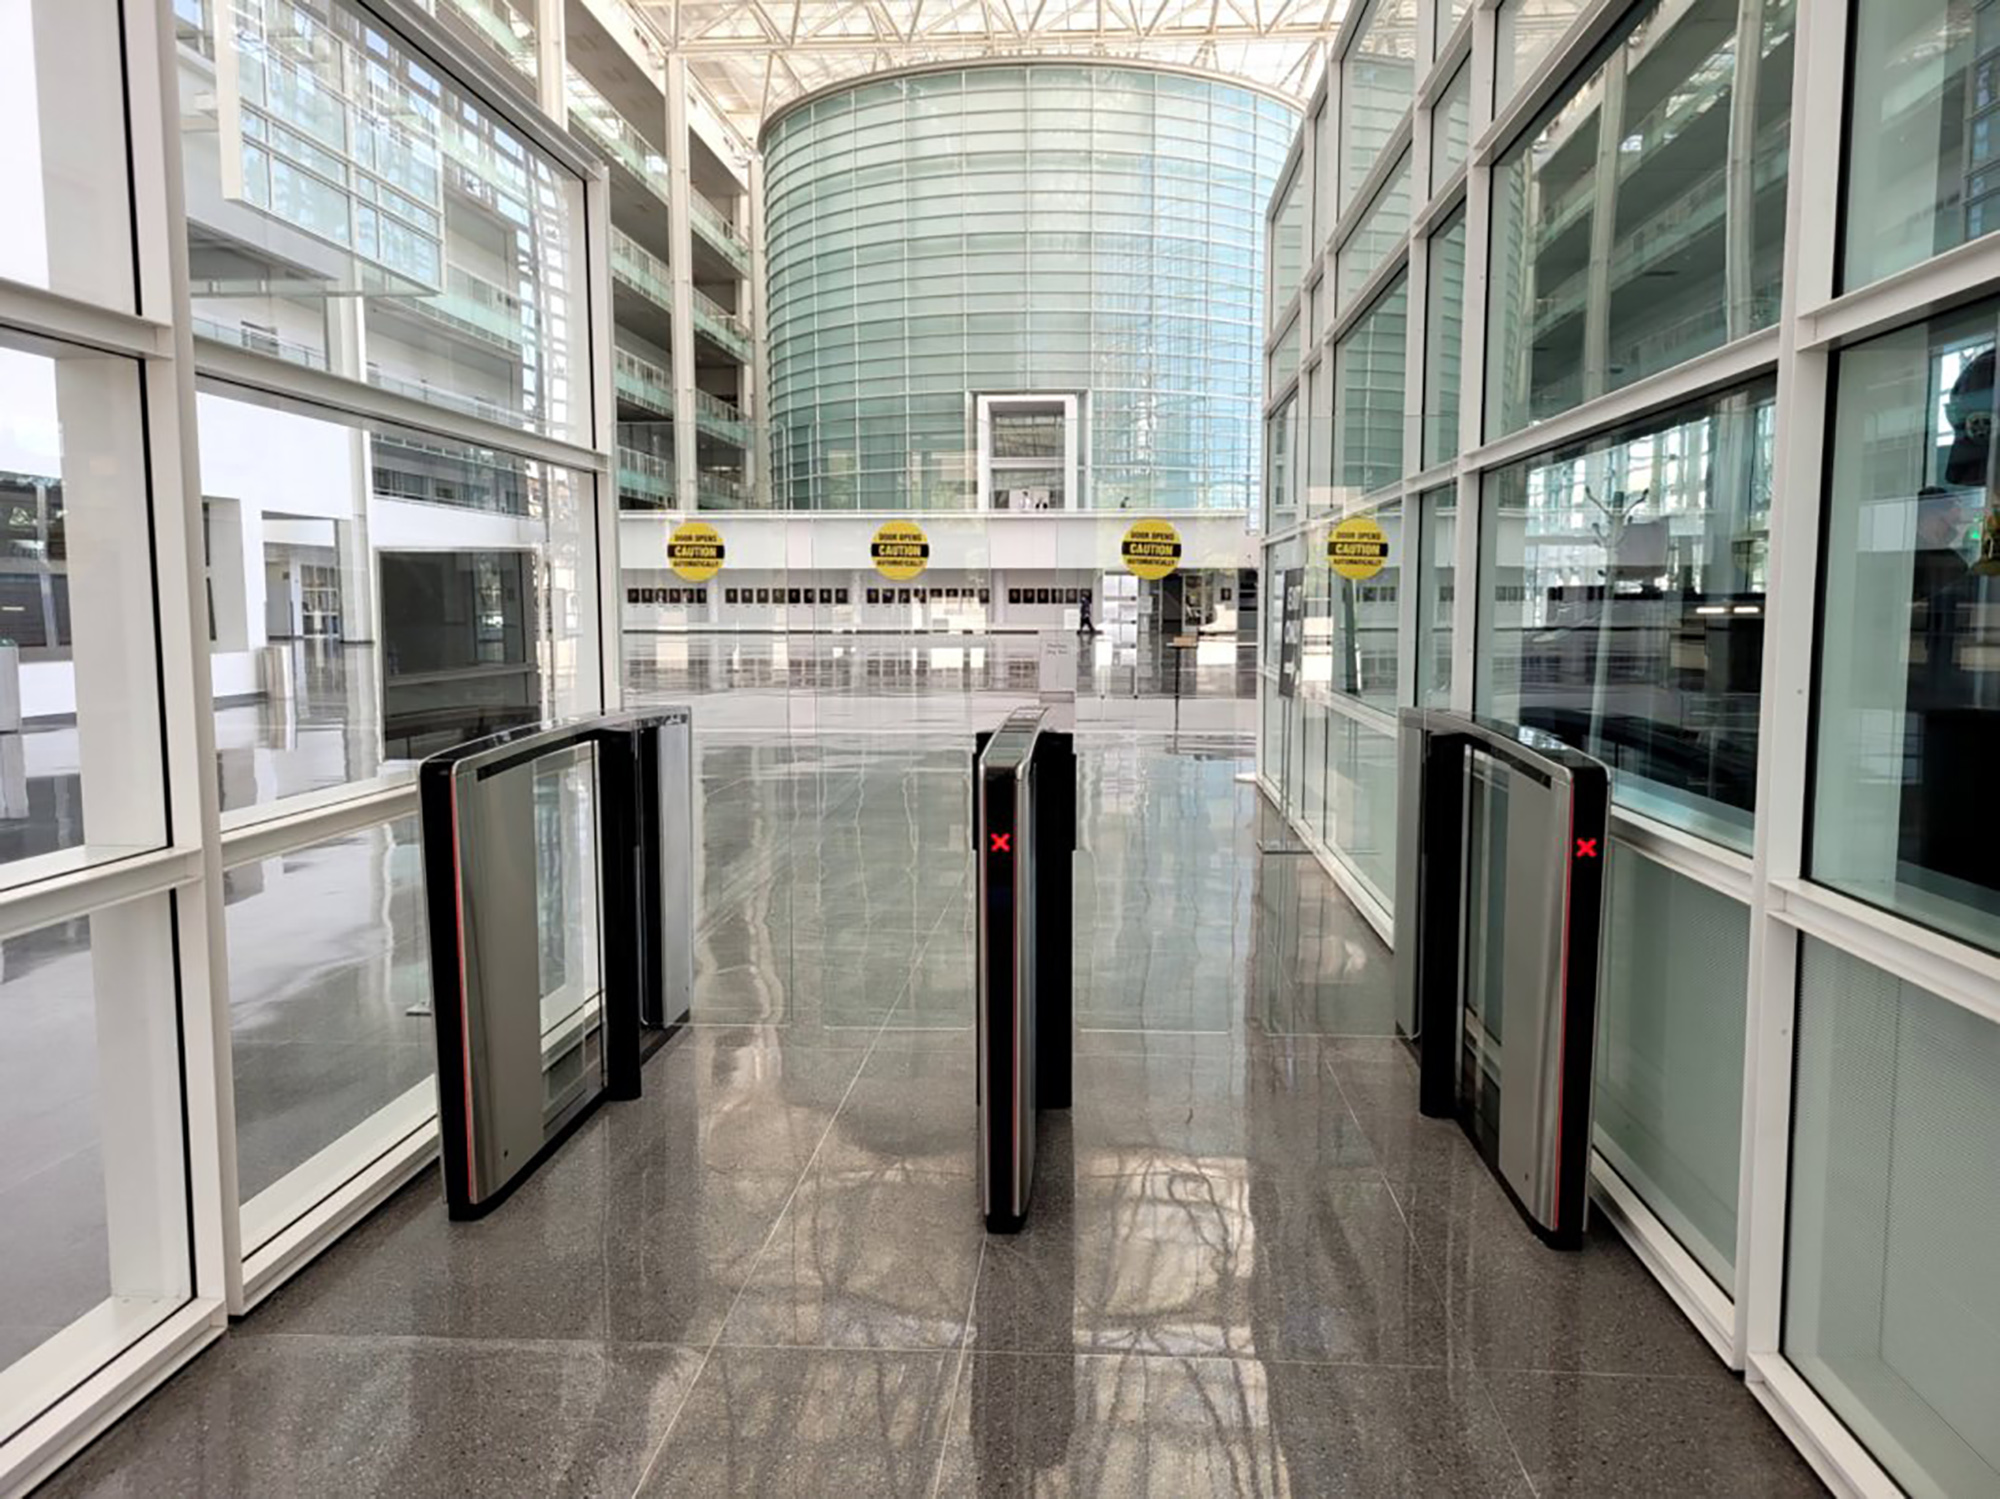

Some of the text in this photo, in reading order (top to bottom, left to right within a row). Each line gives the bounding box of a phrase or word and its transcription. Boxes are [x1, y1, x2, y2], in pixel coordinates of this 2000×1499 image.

[674, 545, 717, 557] CAUTION
[878, 545, 921, 556] CAUTION
[1129, 543, 1173, 555] CAUTION
[1335, 543, 1380, 555] CAUTION
